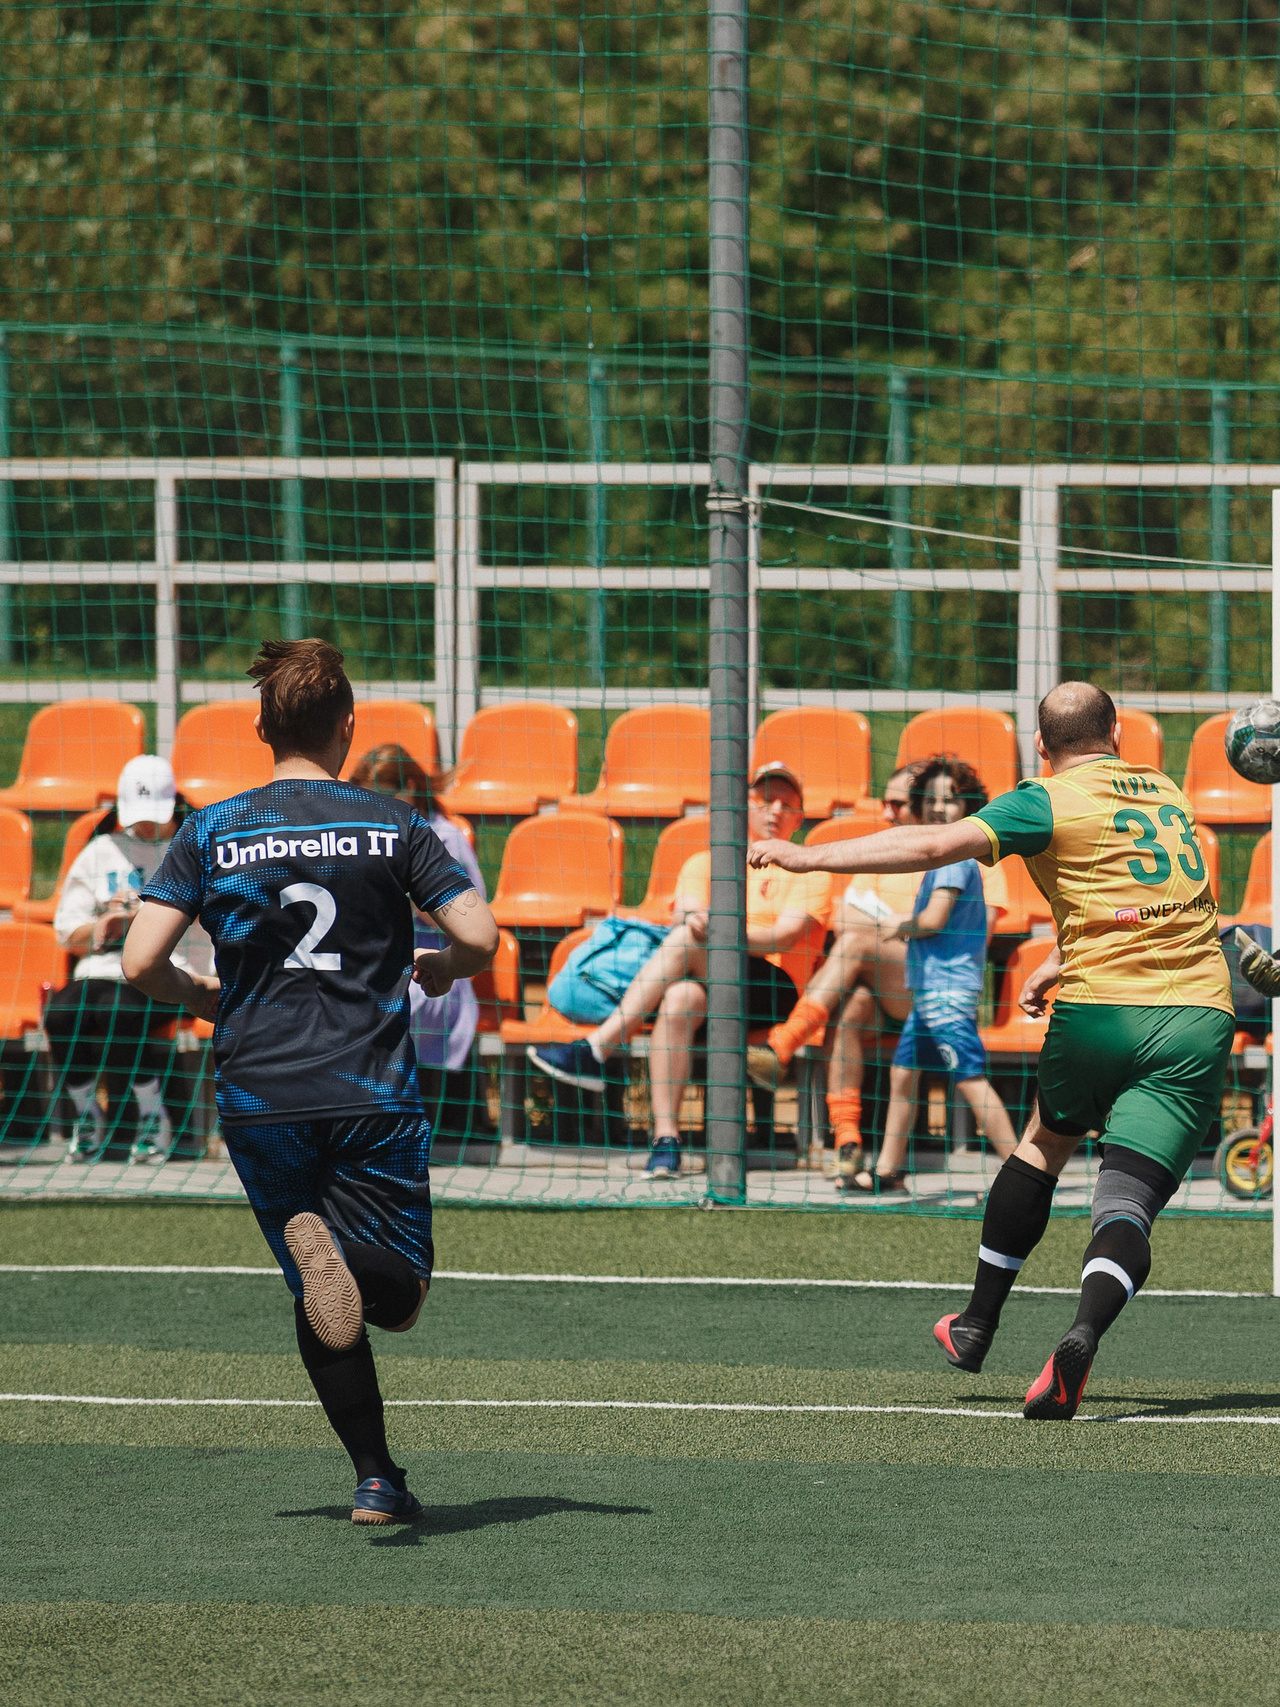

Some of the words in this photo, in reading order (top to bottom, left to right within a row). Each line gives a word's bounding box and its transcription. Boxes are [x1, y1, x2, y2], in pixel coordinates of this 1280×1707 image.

[216, 831, 359, 869] Umbrella
[367, 830, 399, 857] IT
[1113, 804, 1205, 886] 33
[279, 882, 342, 971] 2
